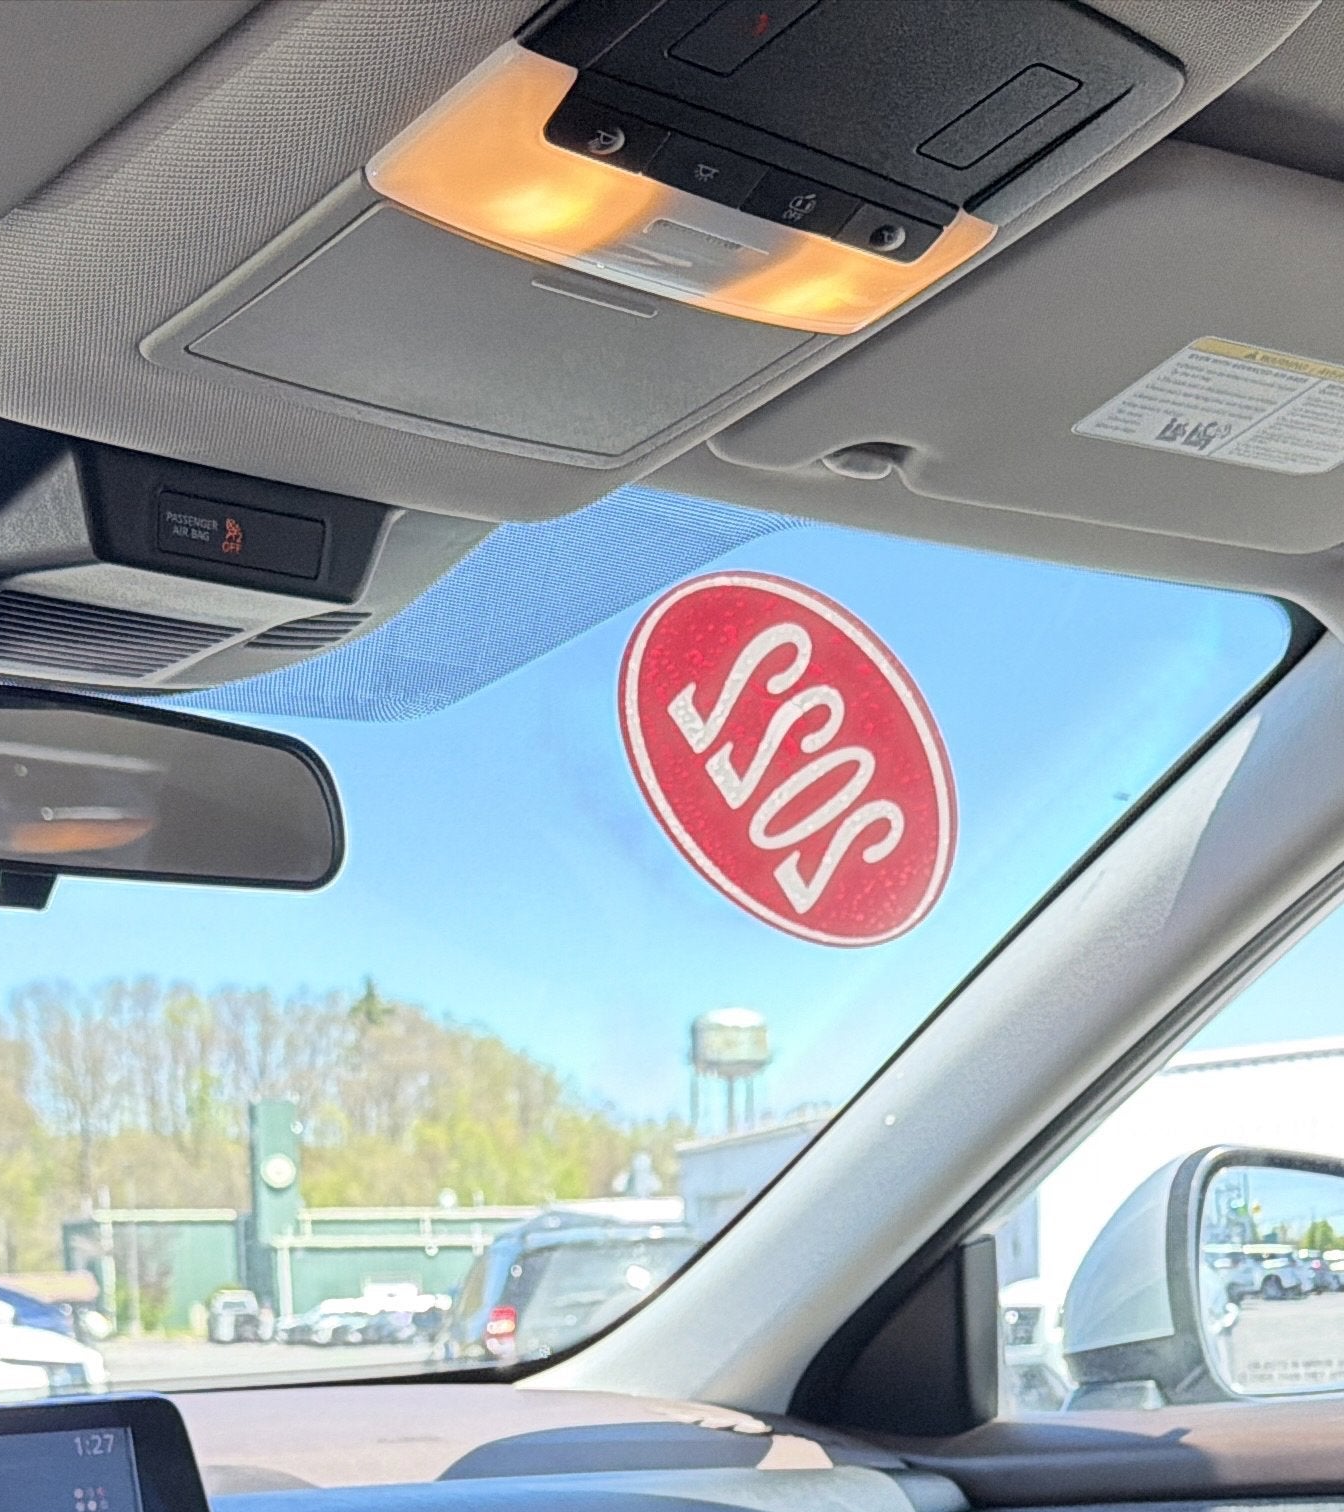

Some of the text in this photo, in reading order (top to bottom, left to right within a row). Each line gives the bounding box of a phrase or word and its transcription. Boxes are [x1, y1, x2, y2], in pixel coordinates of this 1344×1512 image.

[165, 511, 218, 530] PASSENGER
[173, 525, 210, 541] AIR BAG
[221, 541, 240, 554] OFF
[74, 1433, 114, 1456] 1:27
